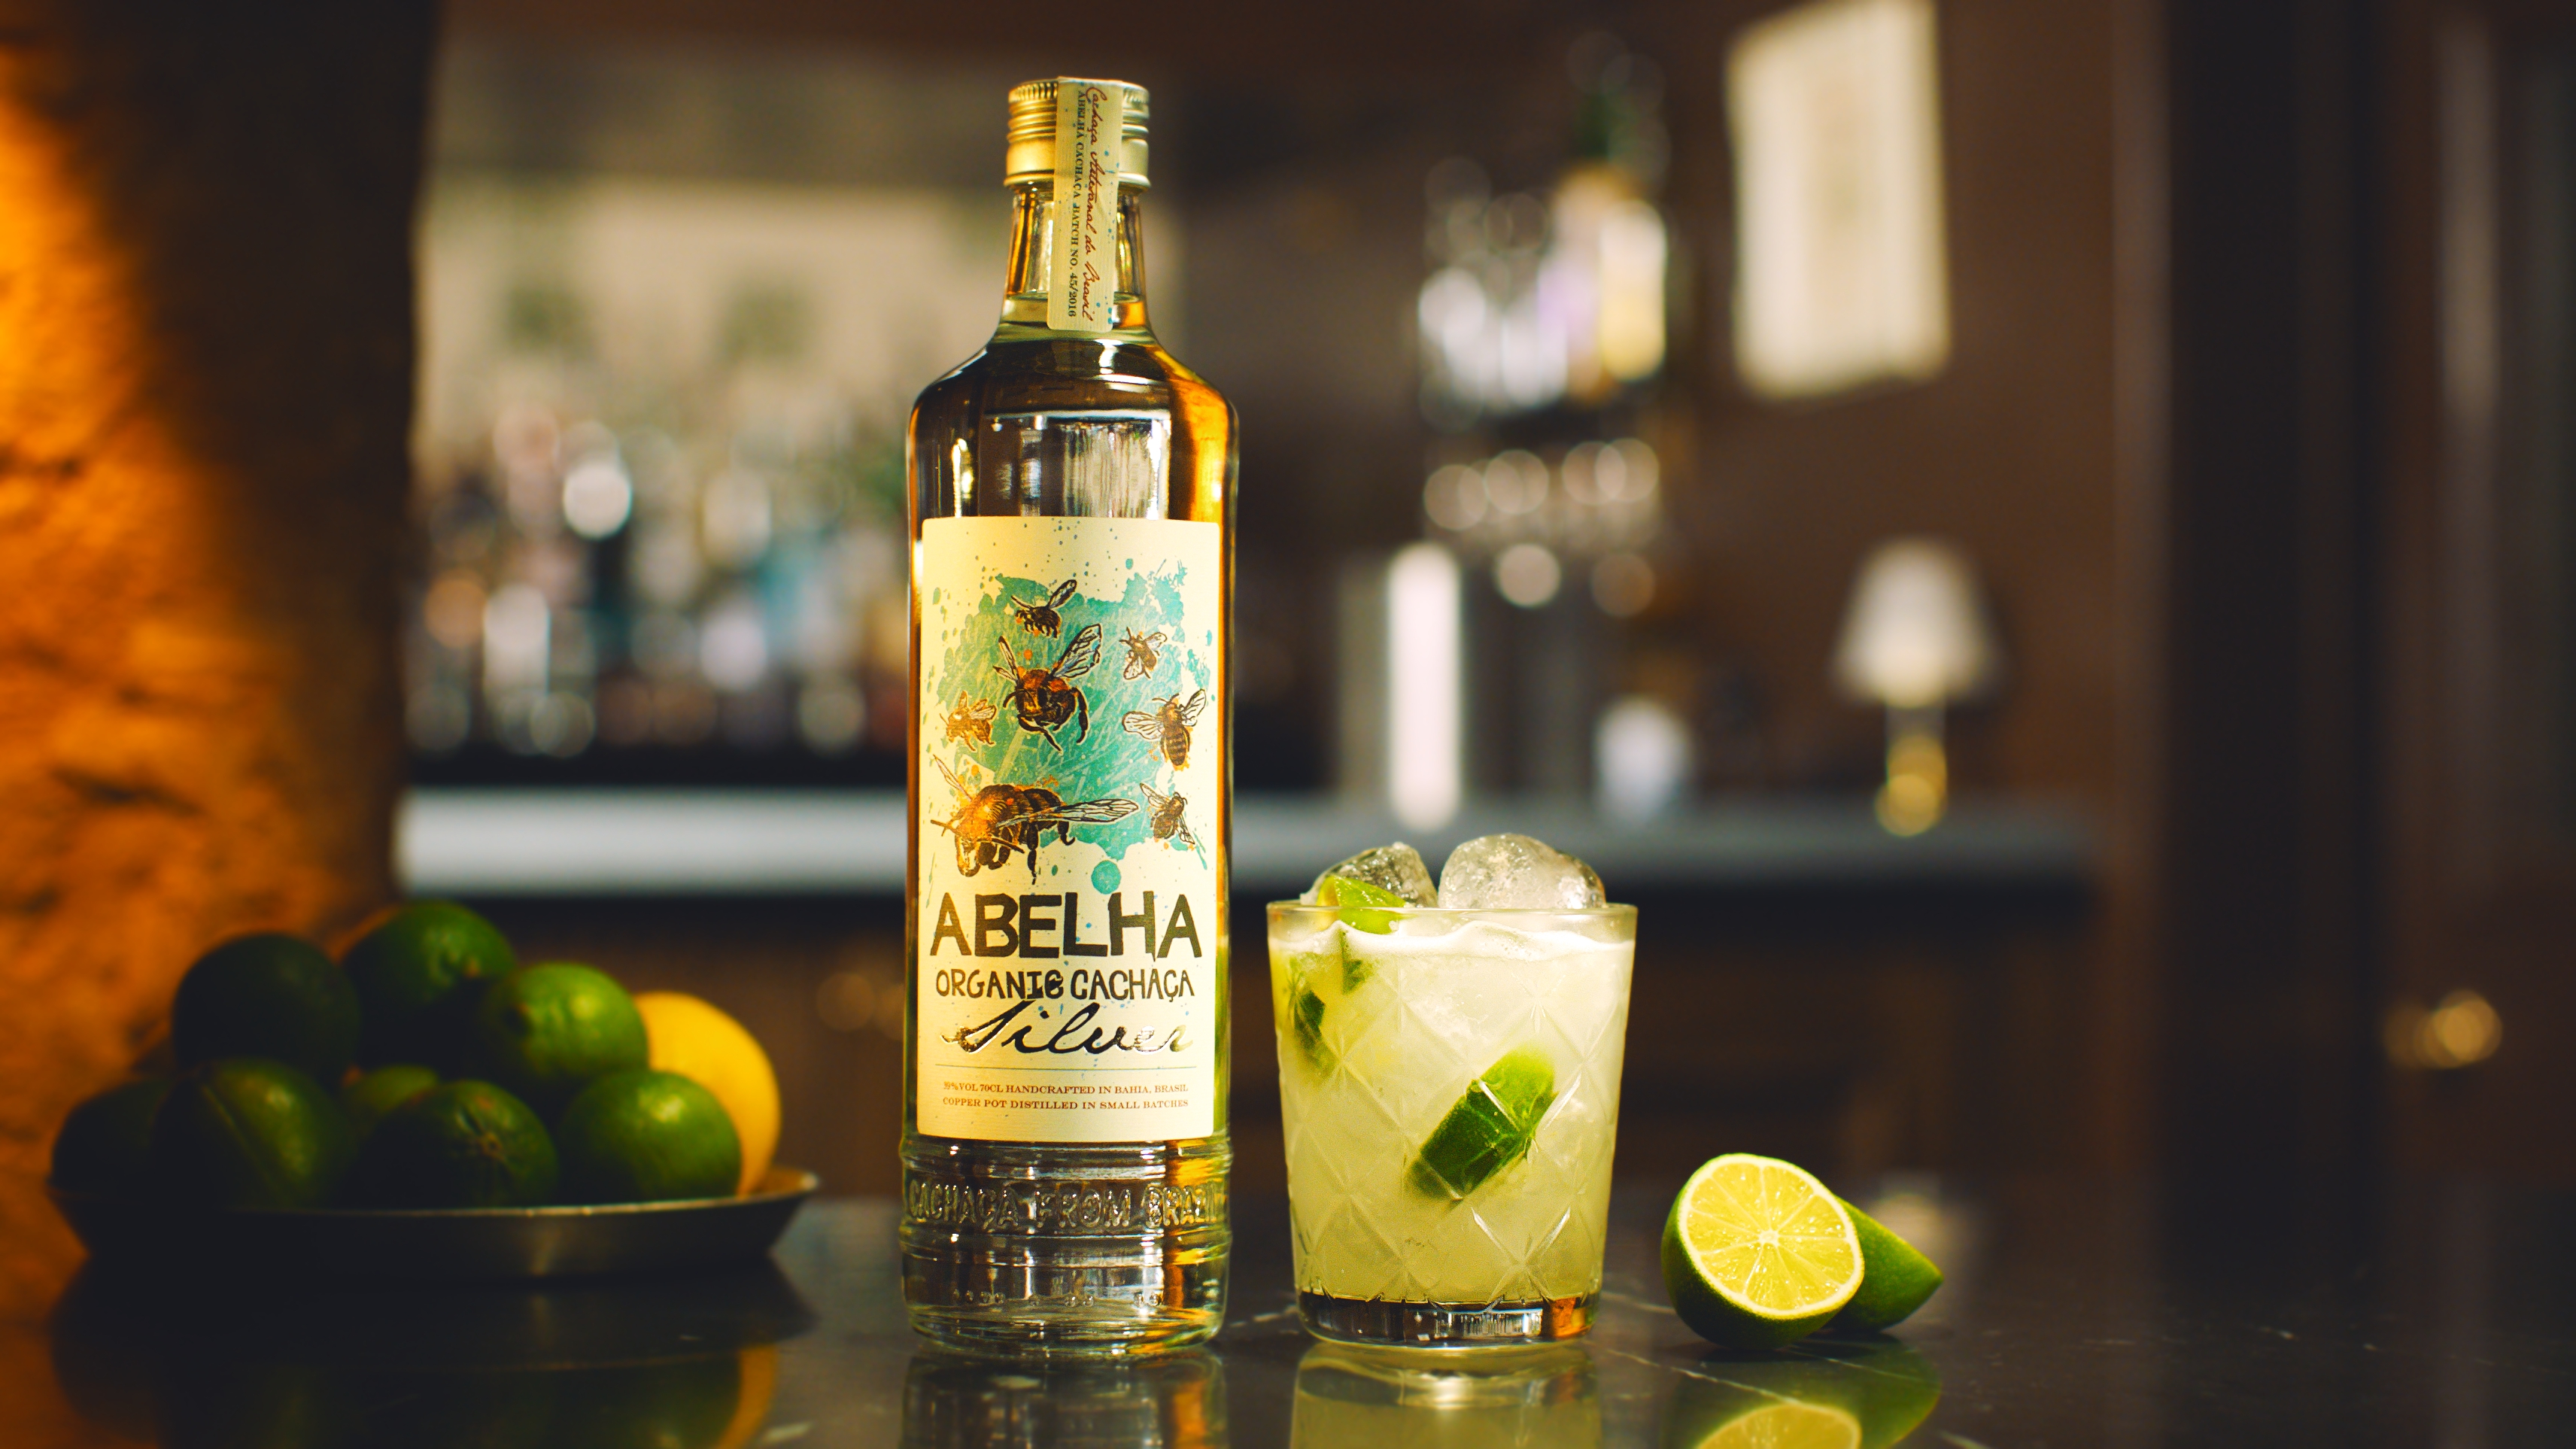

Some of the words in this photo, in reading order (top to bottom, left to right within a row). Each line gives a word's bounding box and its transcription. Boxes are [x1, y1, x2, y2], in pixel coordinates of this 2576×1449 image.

[1077, 90, 1086, 139] ABELHA
[1073, 141, 1085, 198] CACHAÇA
[1071, 205, 1080, 245] BATCH
[930, 890, 1202, 962] ABELHA
[936, 968, 1064, 1000] ORGANIC
[1070, 968, 1195, 1002] CACHAÇA
[940, 999, 1194, 1055] Silver
[943, 1097, 981, 1107] COPPER
[984, 1099, 1007, 1108] POT
[1010, 1100, 1078, 1110] DISTILLED
[1083, 1101, 1096, 1110] IN
[1100, 1101, 1141, 1110] SMALL
[1143, 1099, 1189, 1109] BATCHES
[980, 1084, 1004, 1093] 70CL
[1006, 1084, 1095, 1095] HANDCRAFTED
[1098, 1086, 1112, 1095] IN
[1115, 1086, 1152, 1094] BAHIA,
[1155, 1084, 1189, 1093] BRASIL
[1037, 1187, 1132, 1228] FROM
